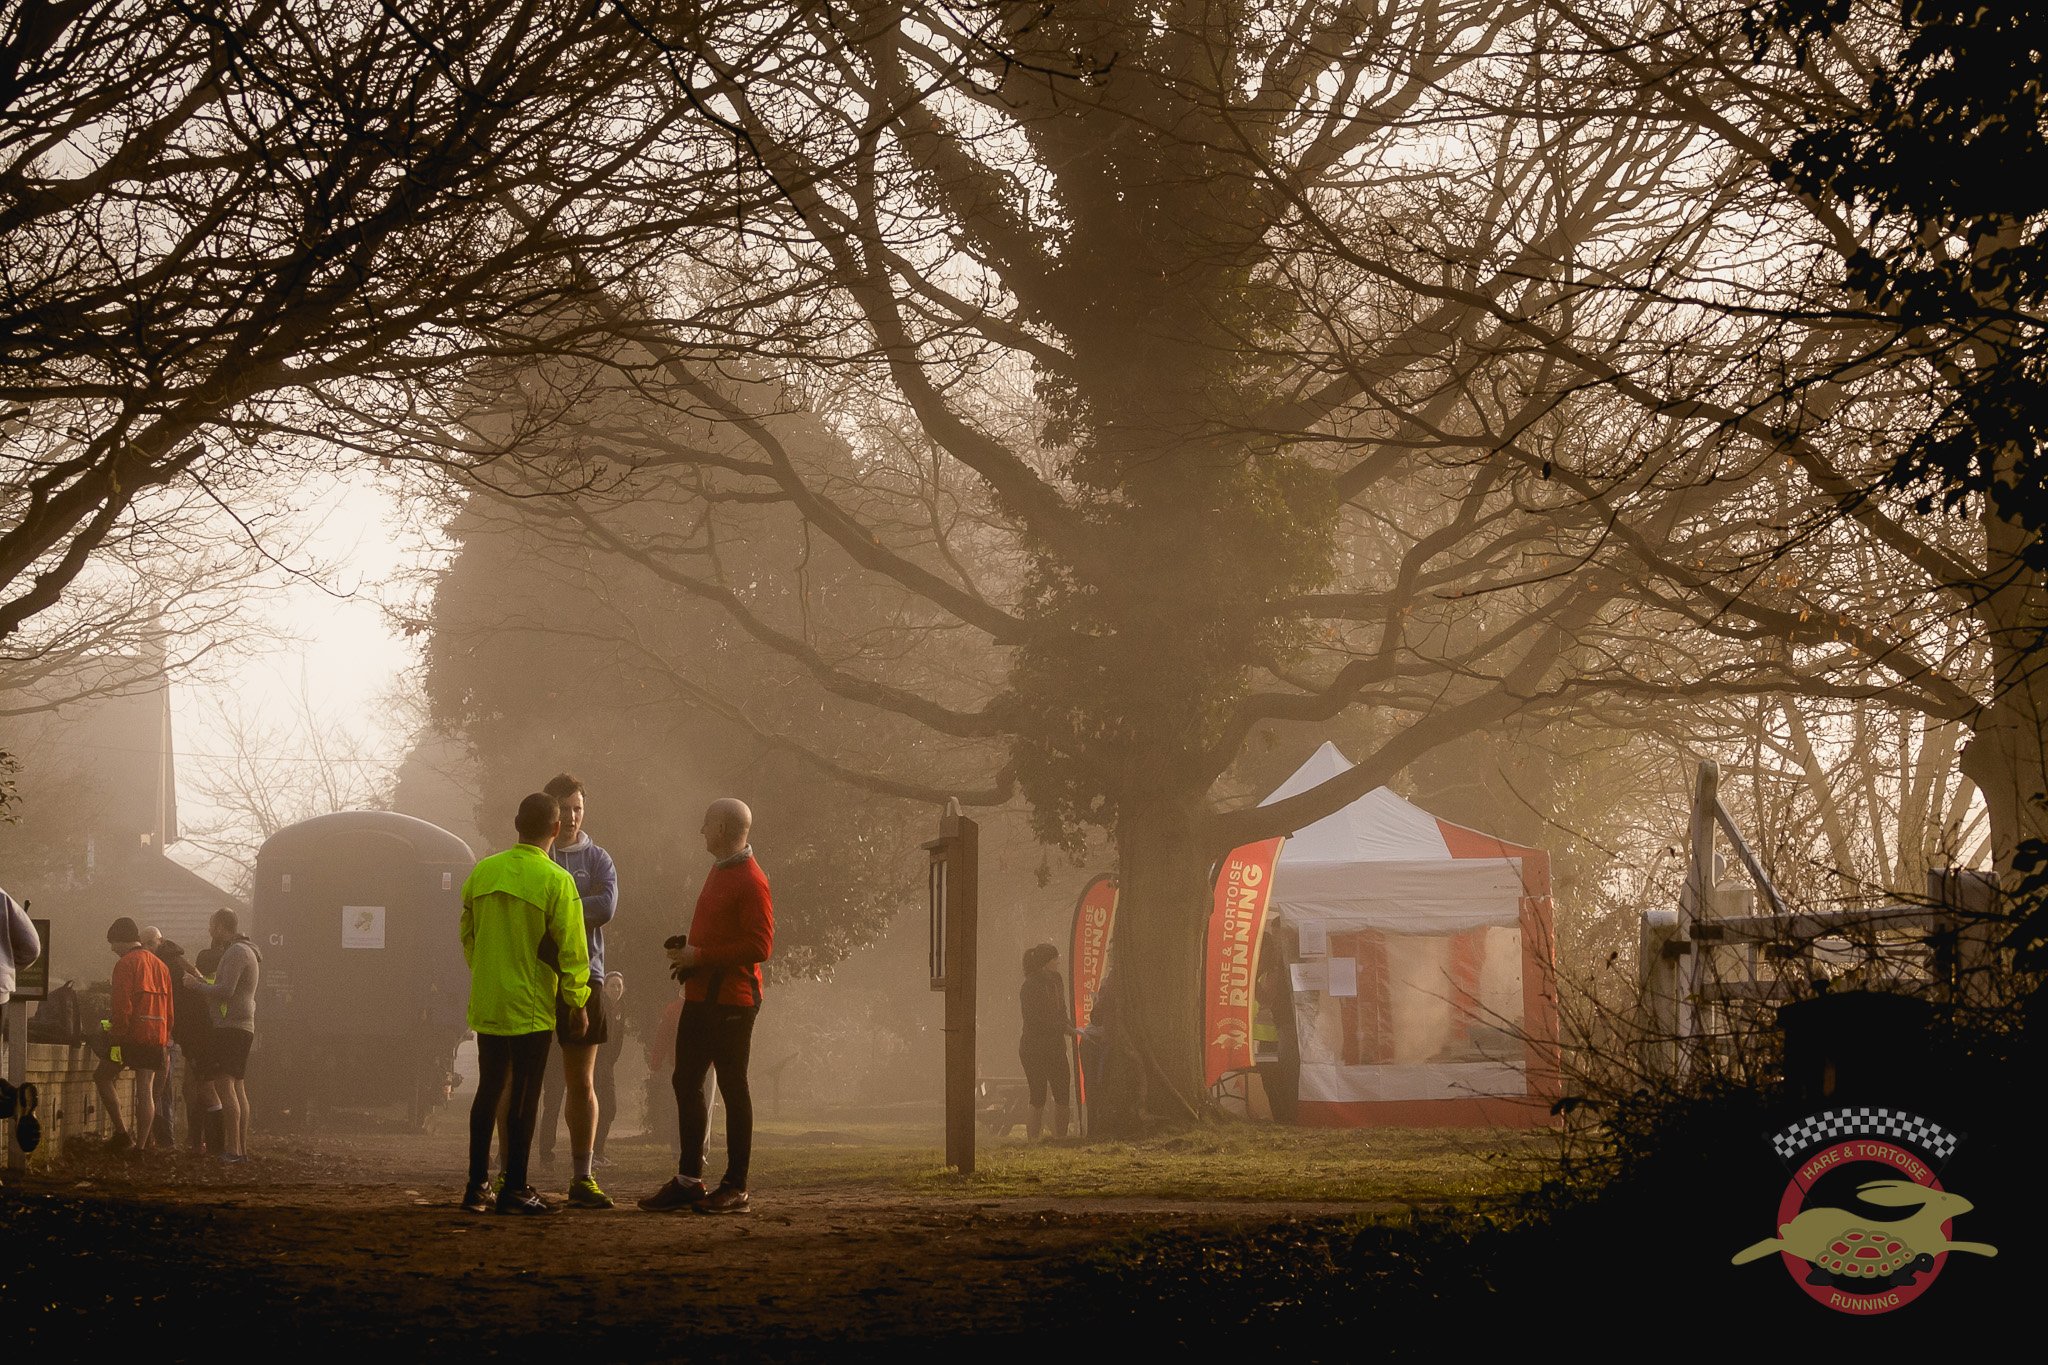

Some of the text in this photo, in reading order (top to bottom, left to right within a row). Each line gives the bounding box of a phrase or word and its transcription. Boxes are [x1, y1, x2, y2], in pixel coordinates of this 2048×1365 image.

[1083, 904, 1095, 975] TORTOISE
[1083, 978, 1092, 987] &
[1219, 860, 1243, 1006] HARE & TORTOISE
[1230, 864, 1263, 1007] RUNNING
